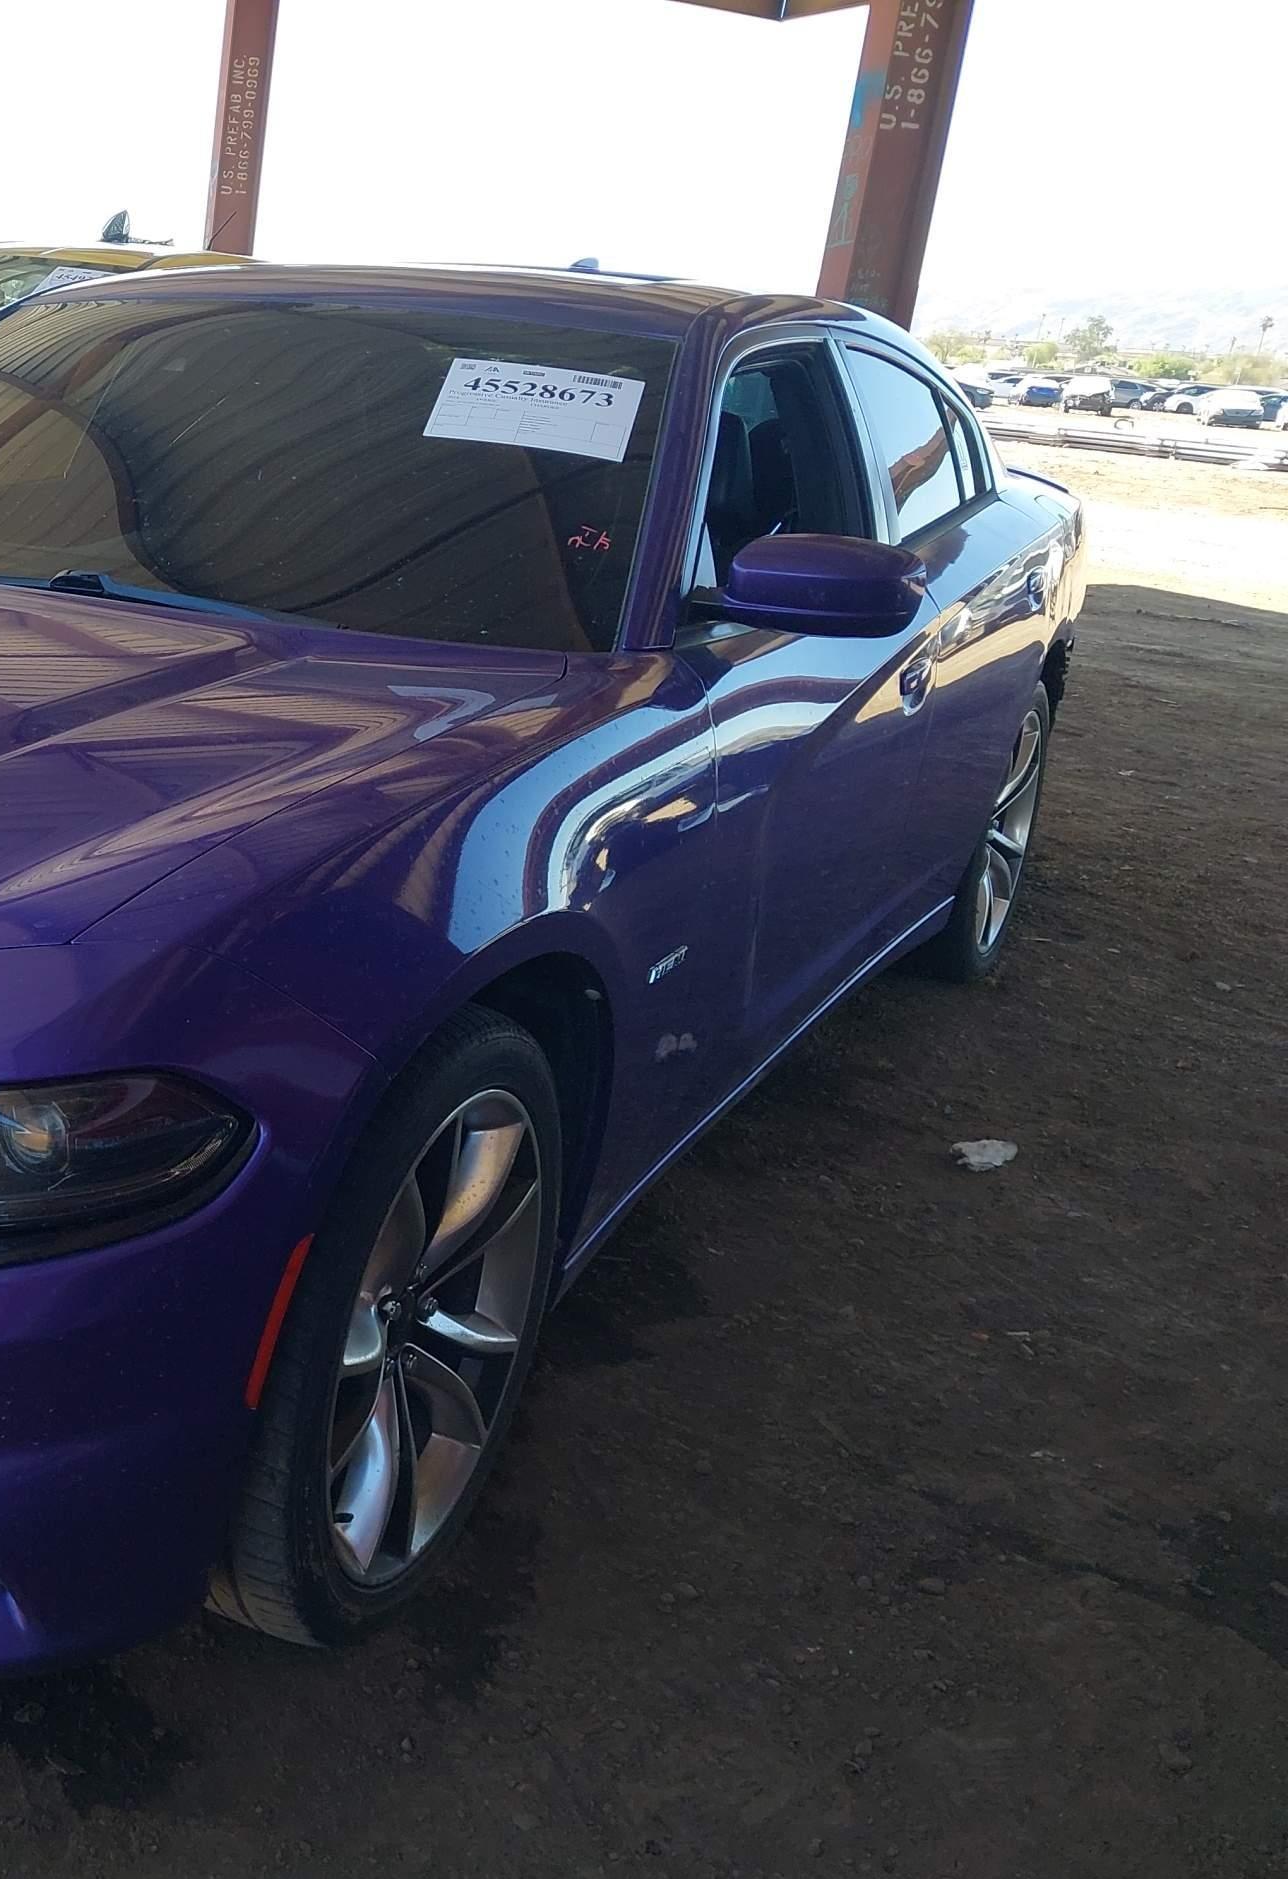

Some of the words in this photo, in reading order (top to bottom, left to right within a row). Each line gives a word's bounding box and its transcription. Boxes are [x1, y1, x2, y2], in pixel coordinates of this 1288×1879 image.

[232, 54, 248, 85] INC.
[225, 93, 242, 156] PREFAB
[880, 76, 906, 130] U.S.
[235, 56, 261, 195] 1-866-799-0969
[220, 165, 235, 195] U.S.
[463, 376, 615, 408] 45528673
